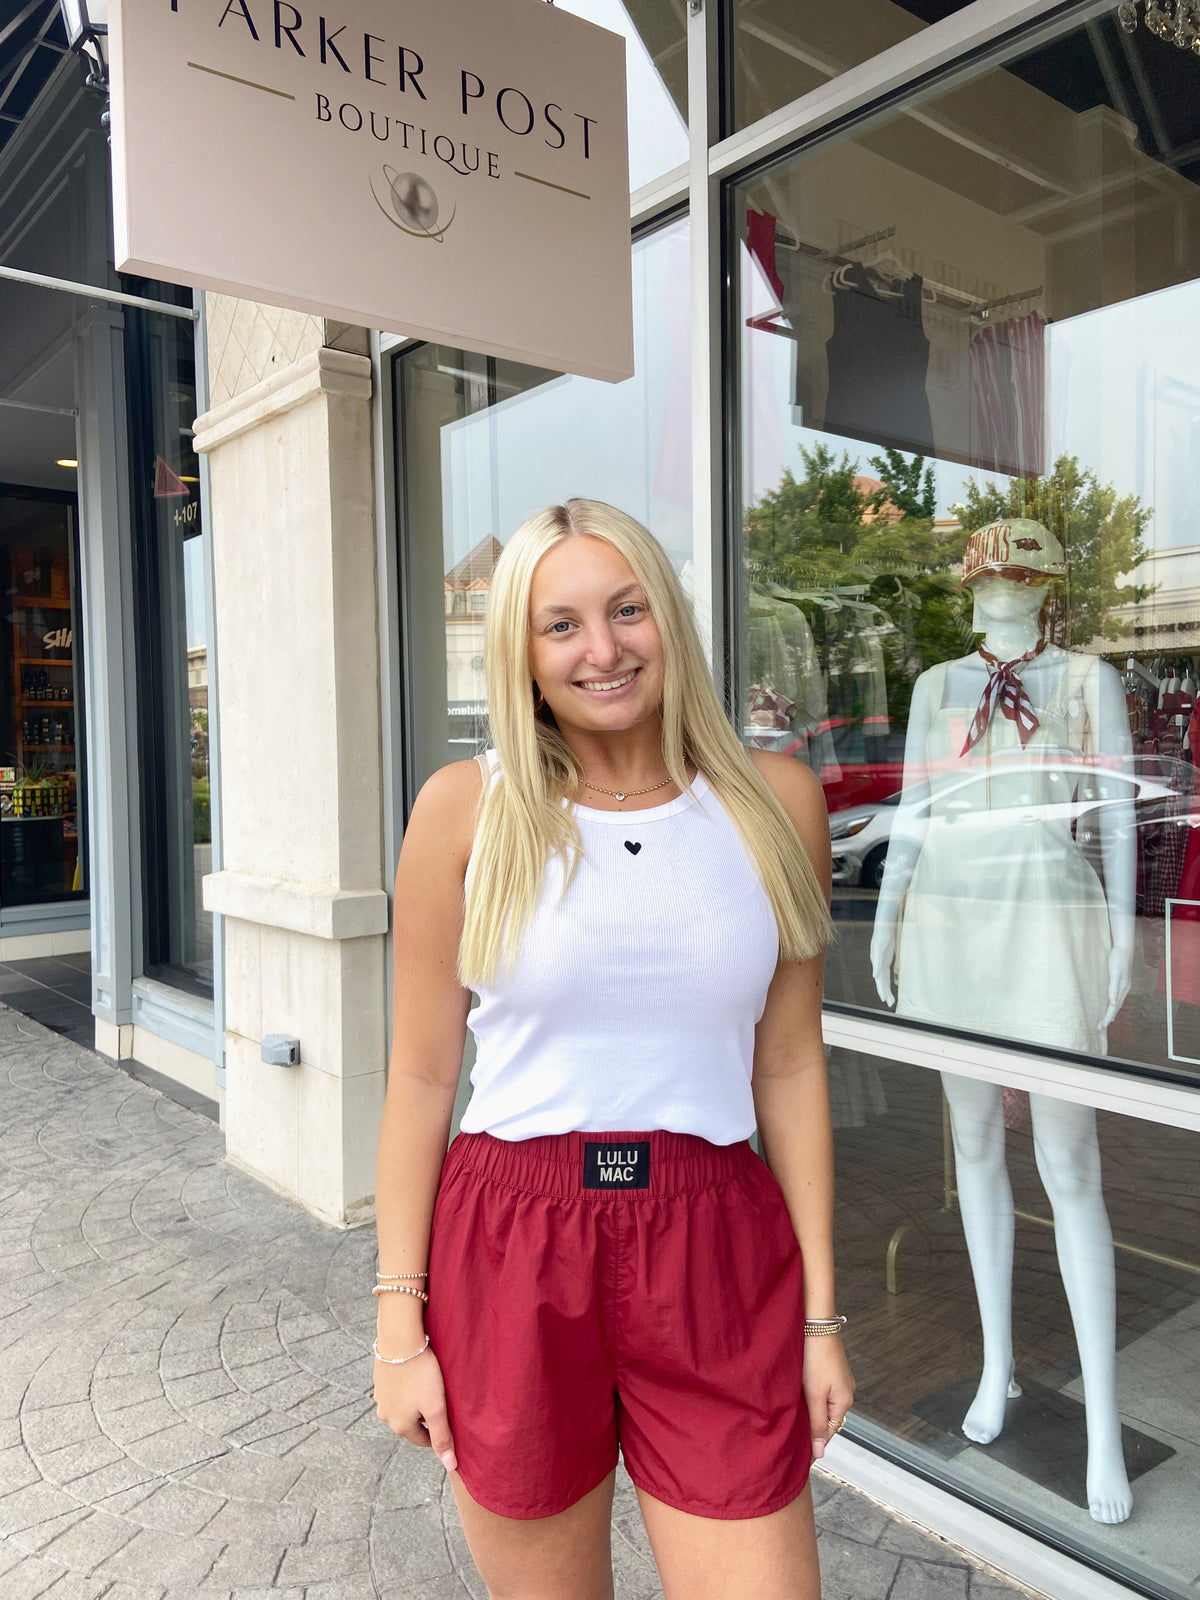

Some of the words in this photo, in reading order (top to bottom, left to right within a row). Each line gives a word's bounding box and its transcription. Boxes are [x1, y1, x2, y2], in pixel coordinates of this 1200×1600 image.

[170, 0, 427, 100] ARKER
[460, 69, 598, 159] POST
[315, 92, 501, 179] BOUTIQUE
[597, 1150, 639, 1166] LULU
[600, 1167, 634, 1182] MAC
